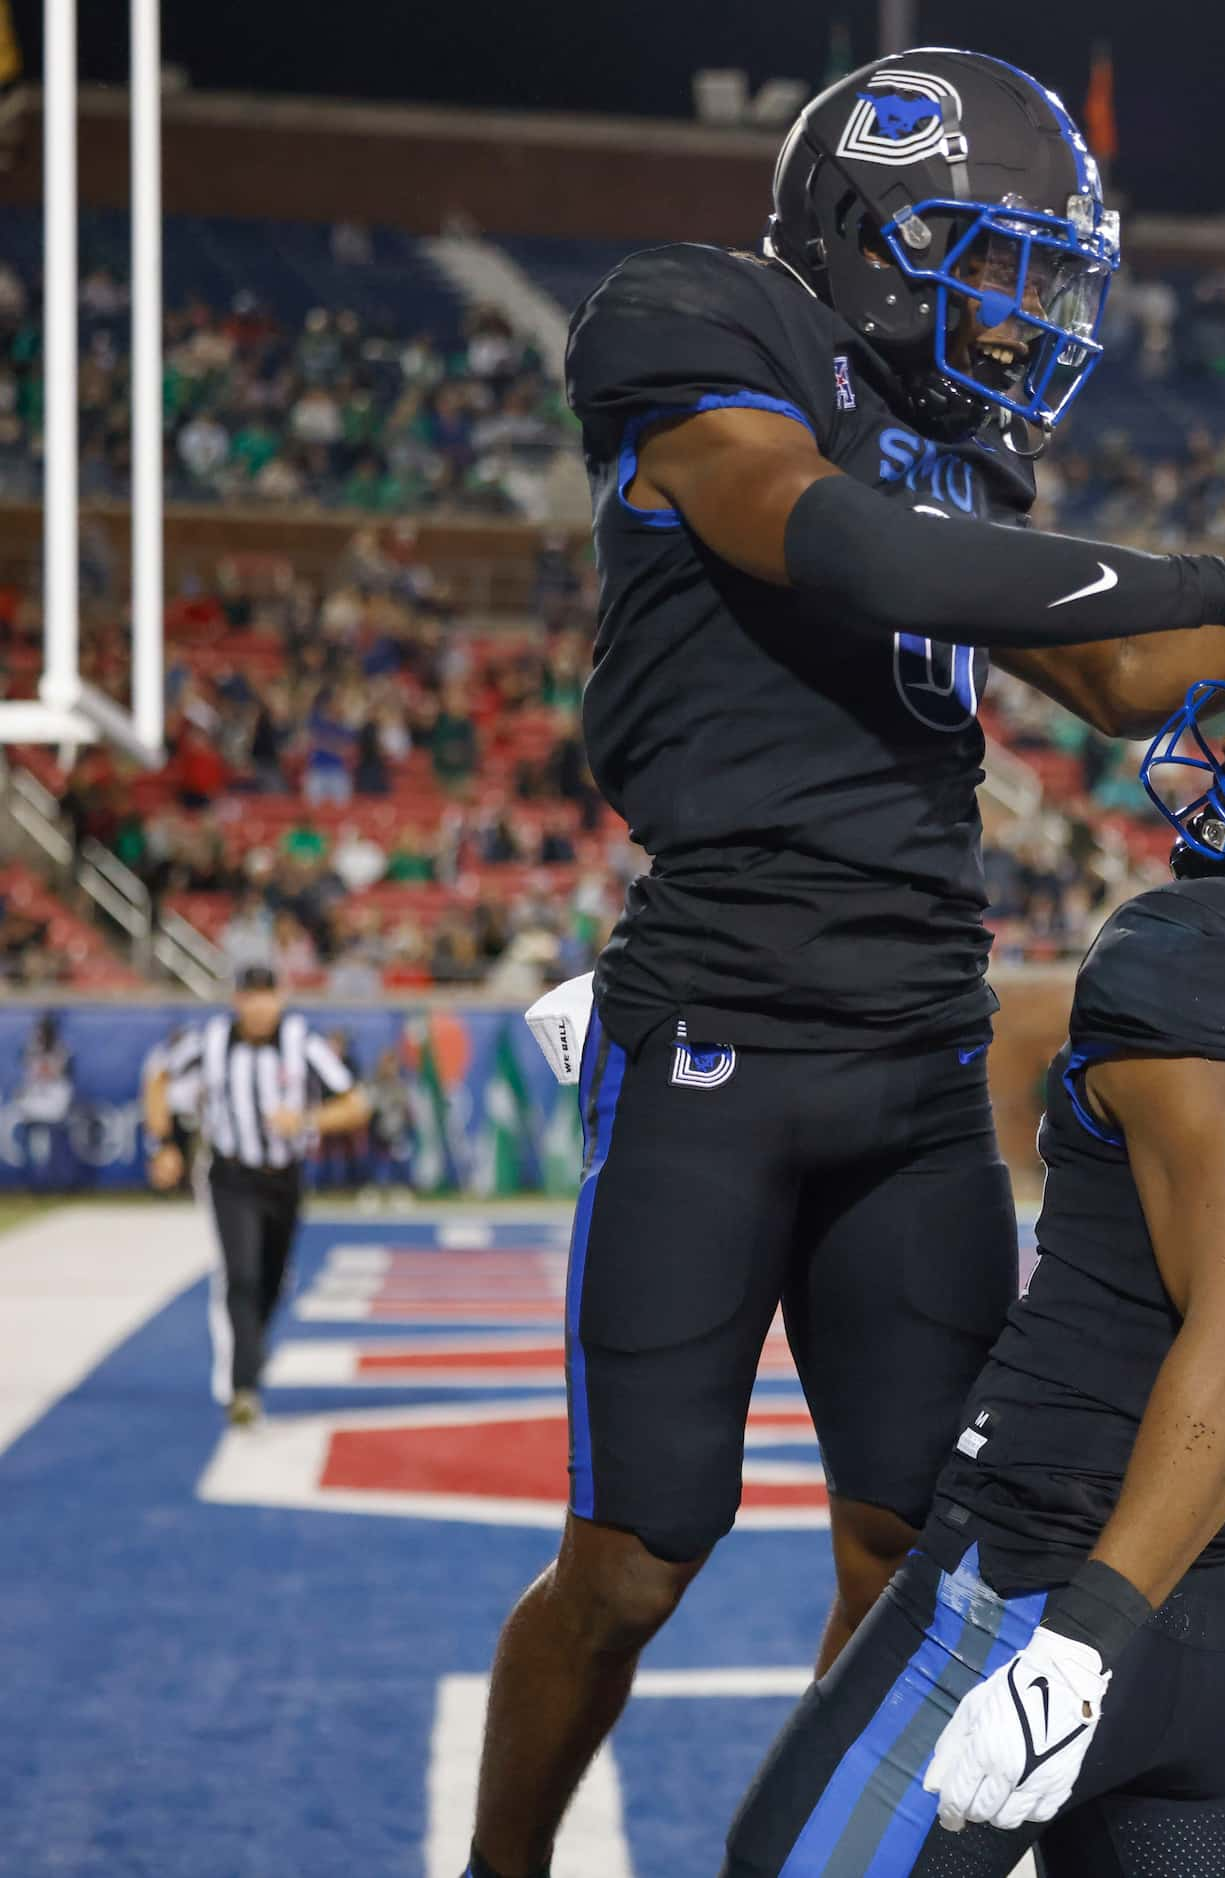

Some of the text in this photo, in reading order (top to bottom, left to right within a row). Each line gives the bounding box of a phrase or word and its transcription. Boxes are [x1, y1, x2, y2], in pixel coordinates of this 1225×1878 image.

[879, 428, 973, 513] SMU
[559, 1019, 572, 1073] WE BALL
